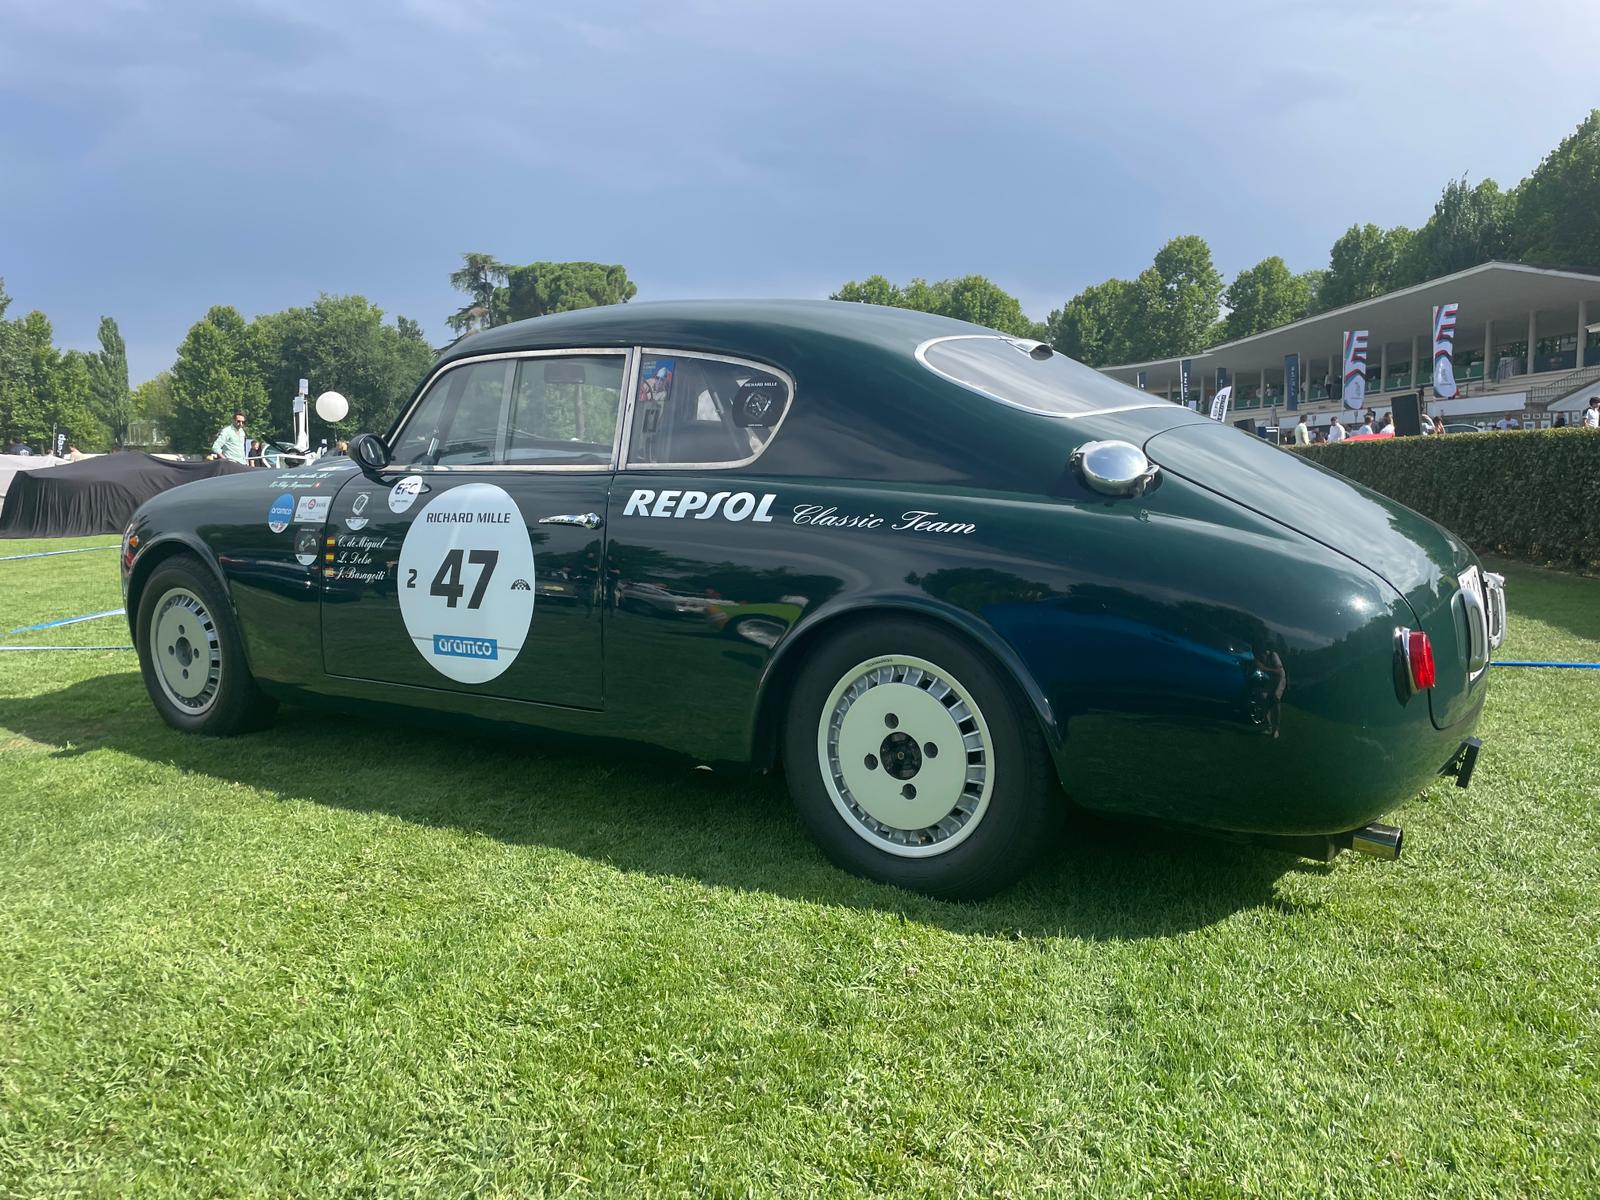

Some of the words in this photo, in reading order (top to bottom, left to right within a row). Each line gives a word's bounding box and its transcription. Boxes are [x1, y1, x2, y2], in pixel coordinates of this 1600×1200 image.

[271, 507, 292, 515] aramco
[622, 489, 777, 522] REPSOL
[426, 512, 474, 523] RICHARD
[476, 512, 511, 524] MILLE
[792, 504, 884, 529] Classic
[891, 510, 976, 535] Team
[337, 551, 347, 564] L.
[406, 568, 418, 588] 2
[430, 549, 499, 610] 47
[438, 638, 492, 656] aramco
